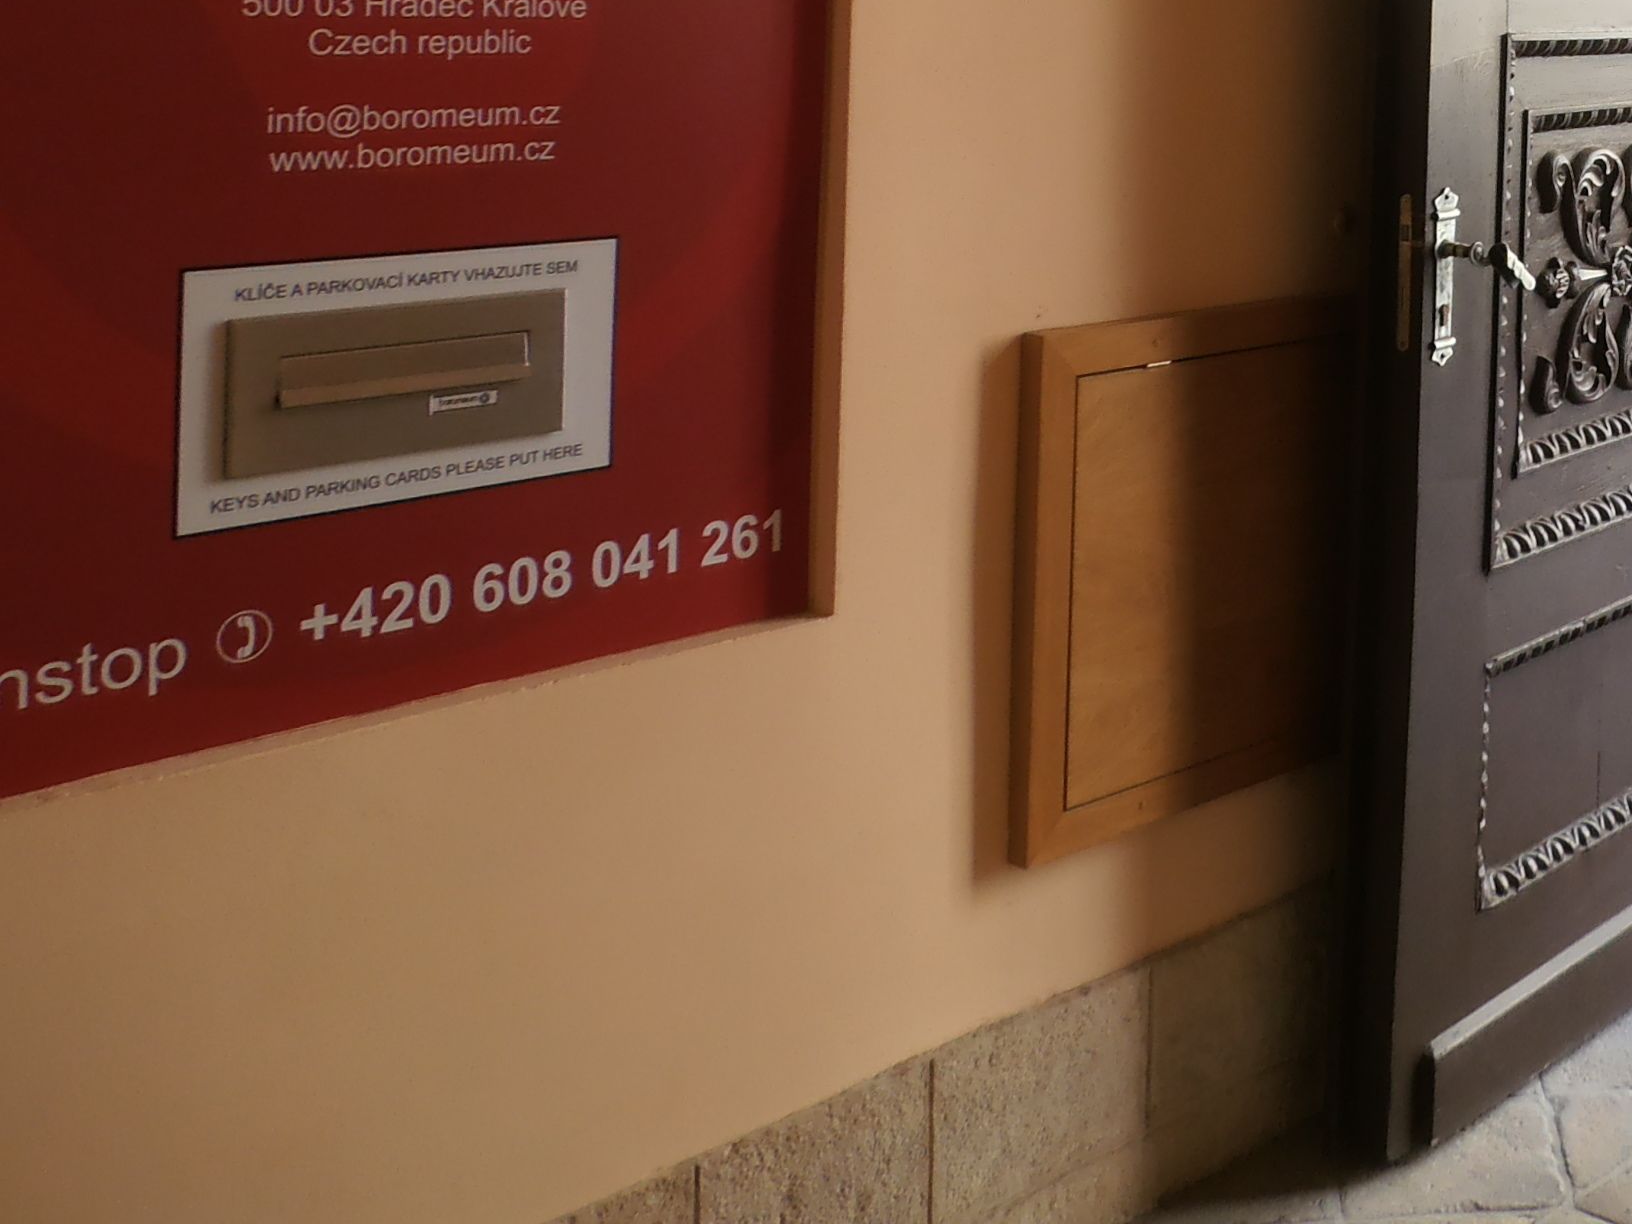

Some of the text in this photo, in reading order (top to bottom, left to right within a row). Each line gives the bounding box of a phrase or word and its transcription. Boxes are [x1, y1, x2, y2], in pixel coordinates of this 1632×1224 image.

[308, 28, 532, 60] Czech republic
[266, 103, 562, 139] info@boromeum.cz
[269, 139, 556, 172] www.boromeum.cz
[235, 259, 579, 303] KLÍČE A PARKOVACÍ KARTY VHAZUJTE SEM
[210, 442, 584, 515] KEYS AND PARKING CARDS PLEASE PUT HERE
[300, 508, 785, 642] +420 608 041 261
